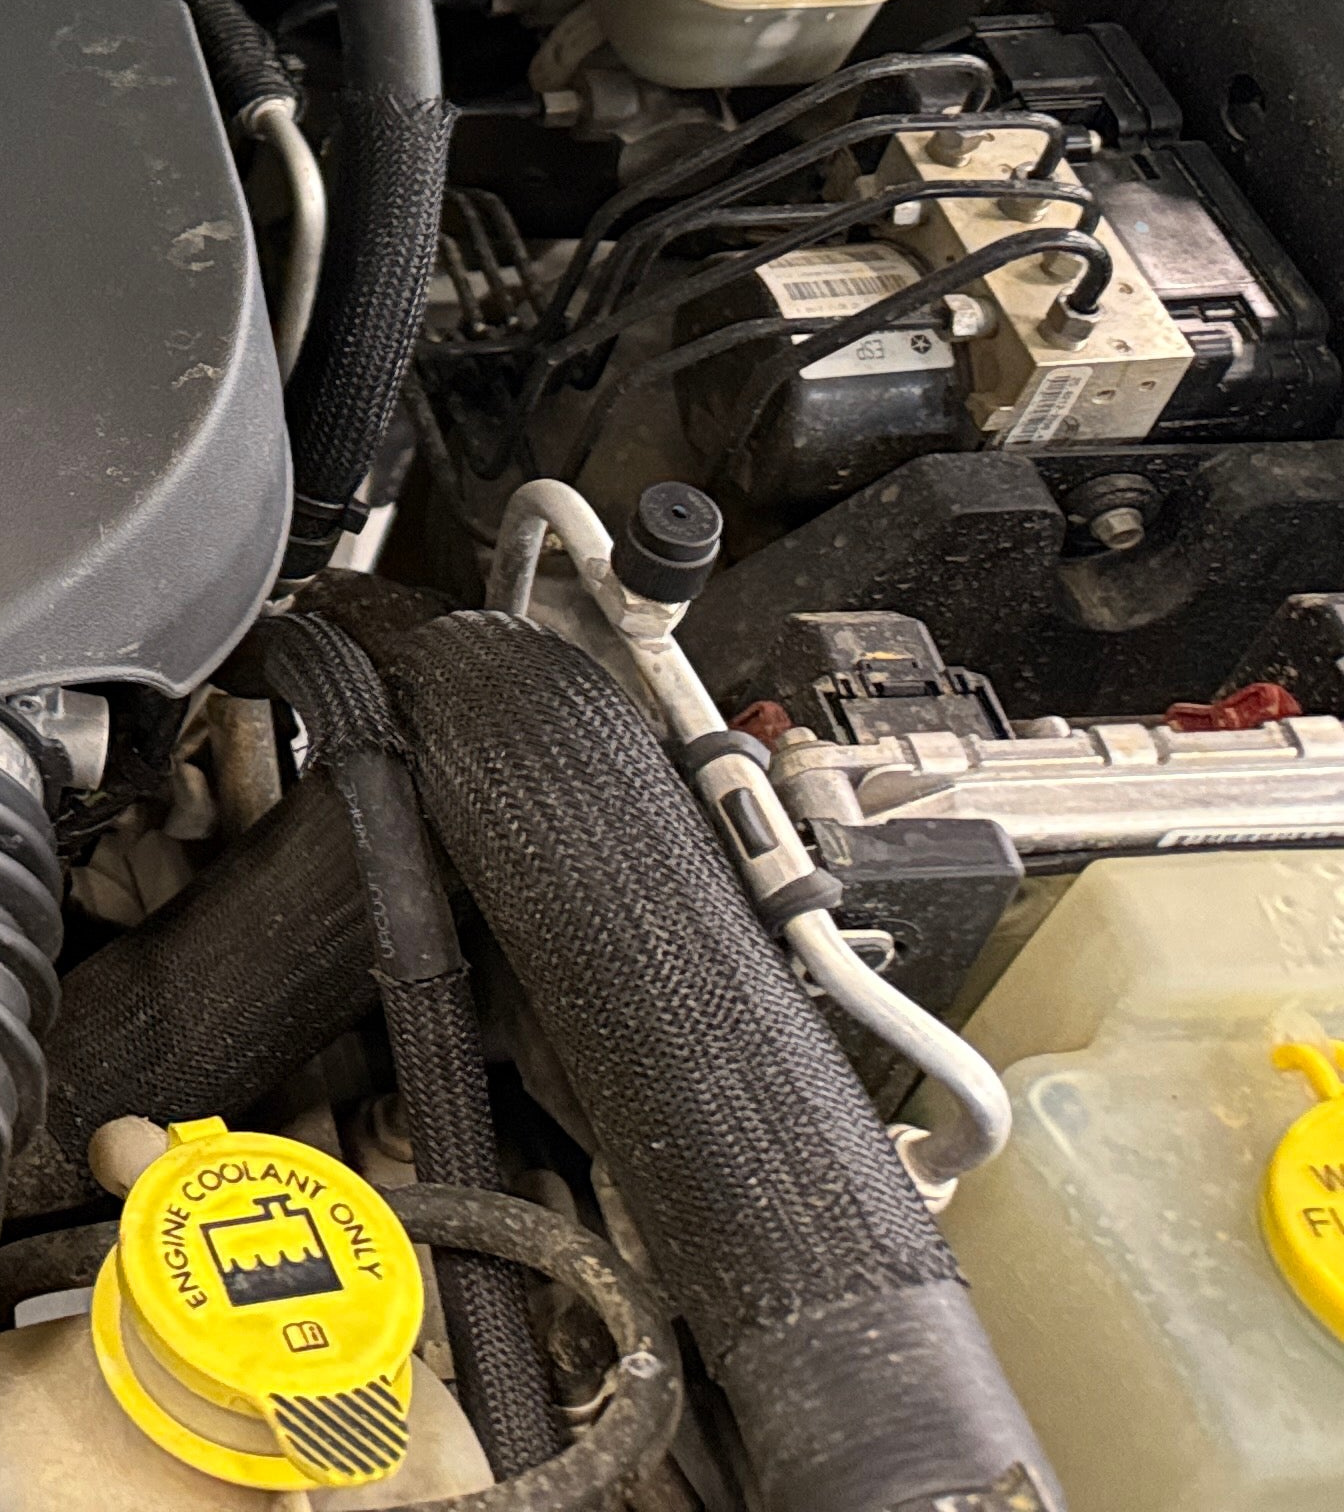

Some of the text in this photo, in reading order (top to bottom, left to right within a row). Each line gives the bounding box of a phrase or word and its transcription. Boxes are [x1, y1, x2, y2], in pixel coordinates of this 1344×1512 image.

[856, 338, 886, 362] ESP
[161, 1160, 384, 1310] ENGINE COOLANT ONLY
